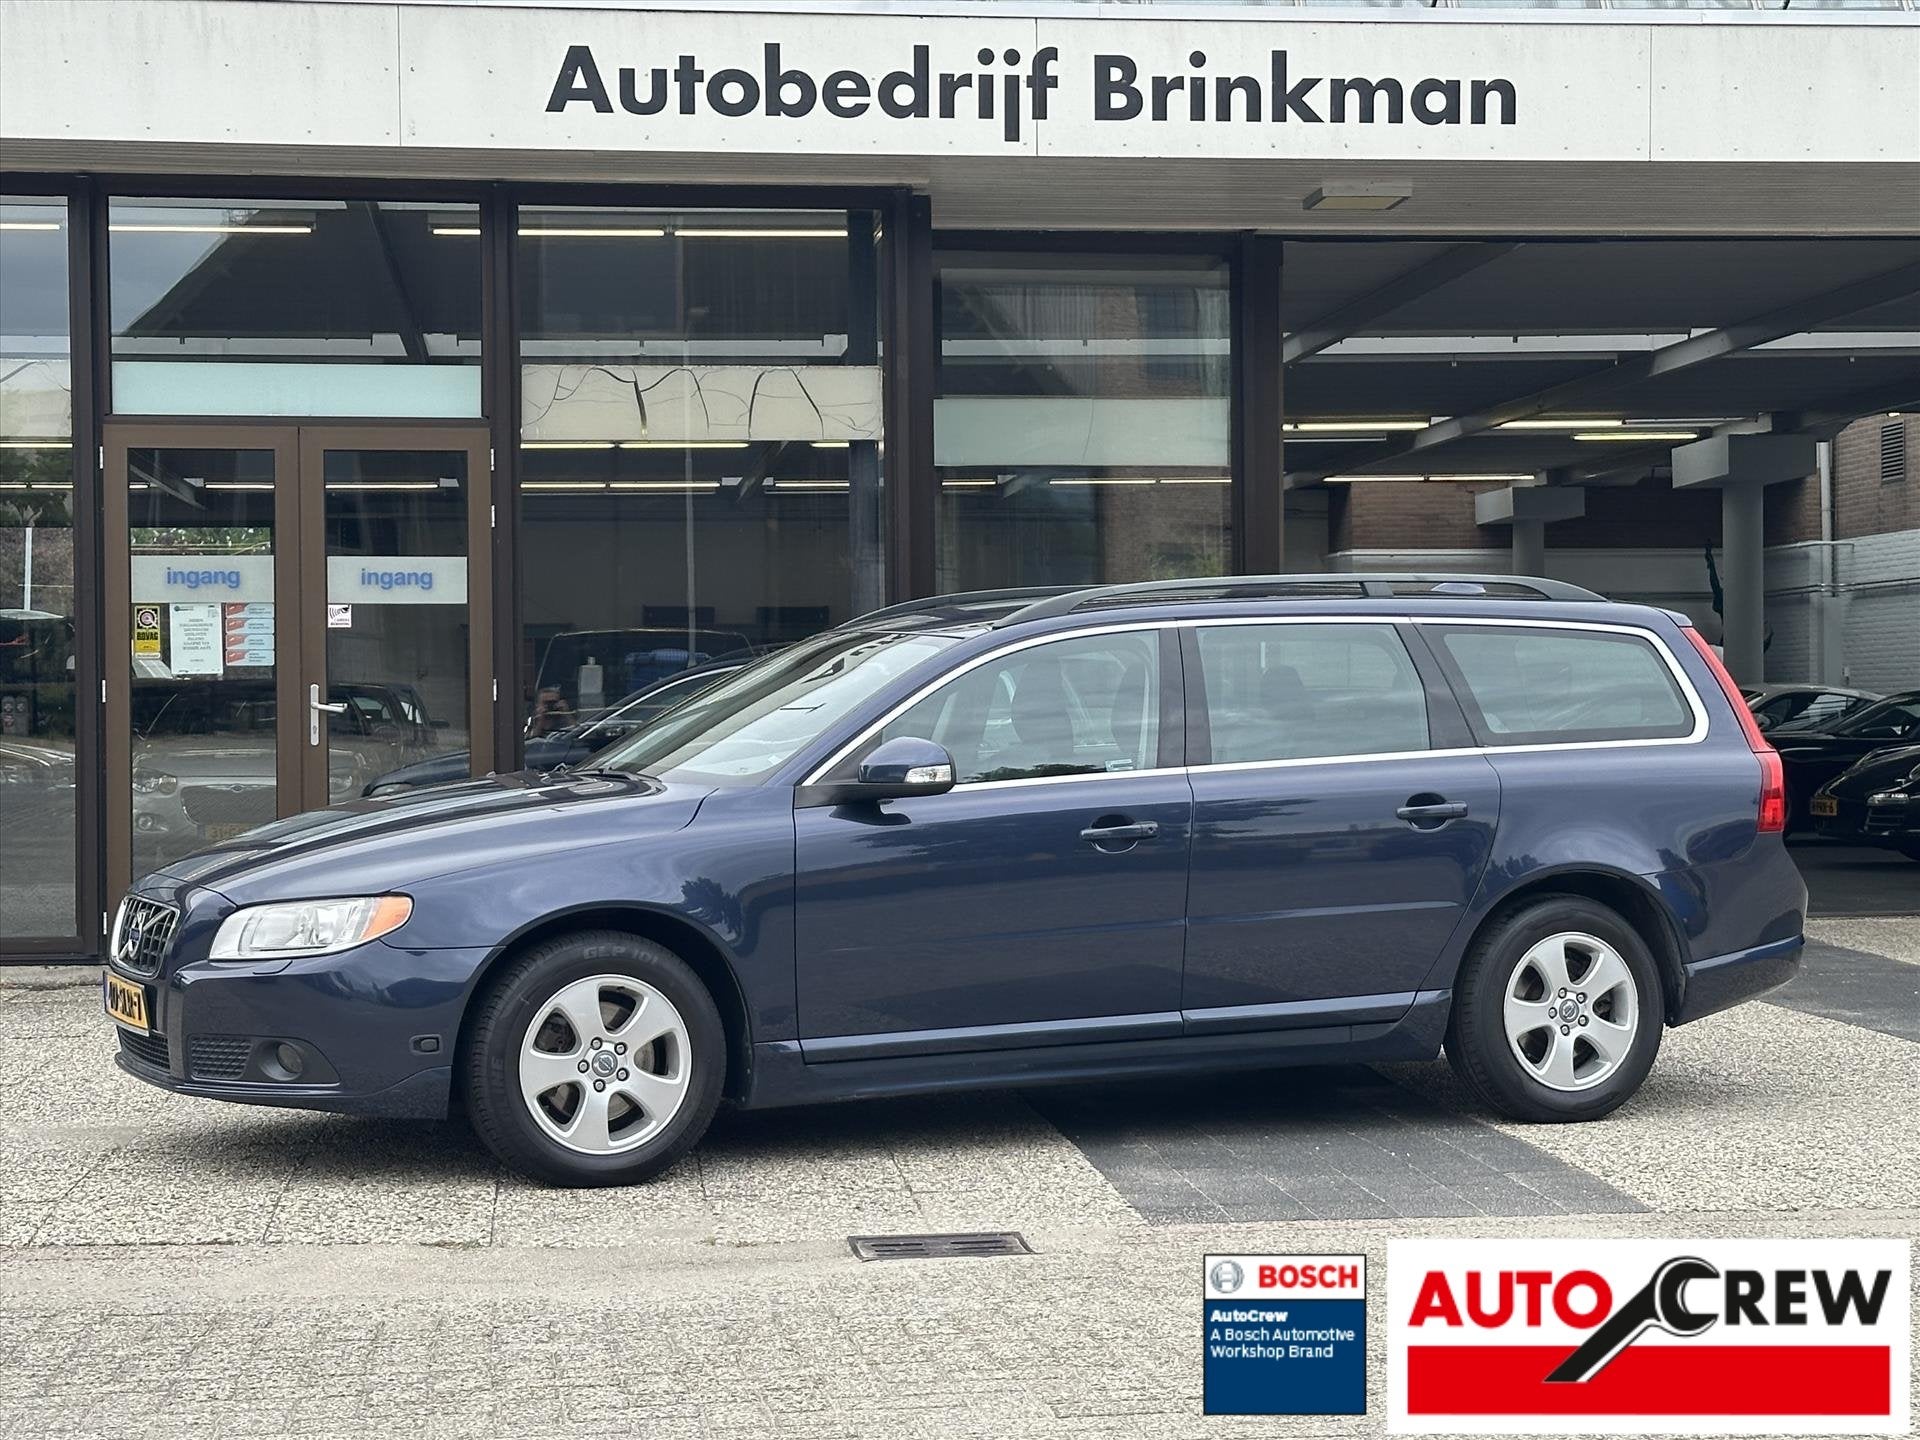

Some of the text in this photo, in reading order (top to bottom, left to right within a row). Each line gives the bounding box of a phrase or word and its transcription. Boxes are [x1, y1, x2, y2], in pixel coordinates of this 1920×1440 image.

[546, 43, 1516, 142] Autobedrijf Brinkman
[166, 567, 241, 589] ingang
[361, 568, 433, 590] ingang
[136, 631, 159, 641] BOVAG
